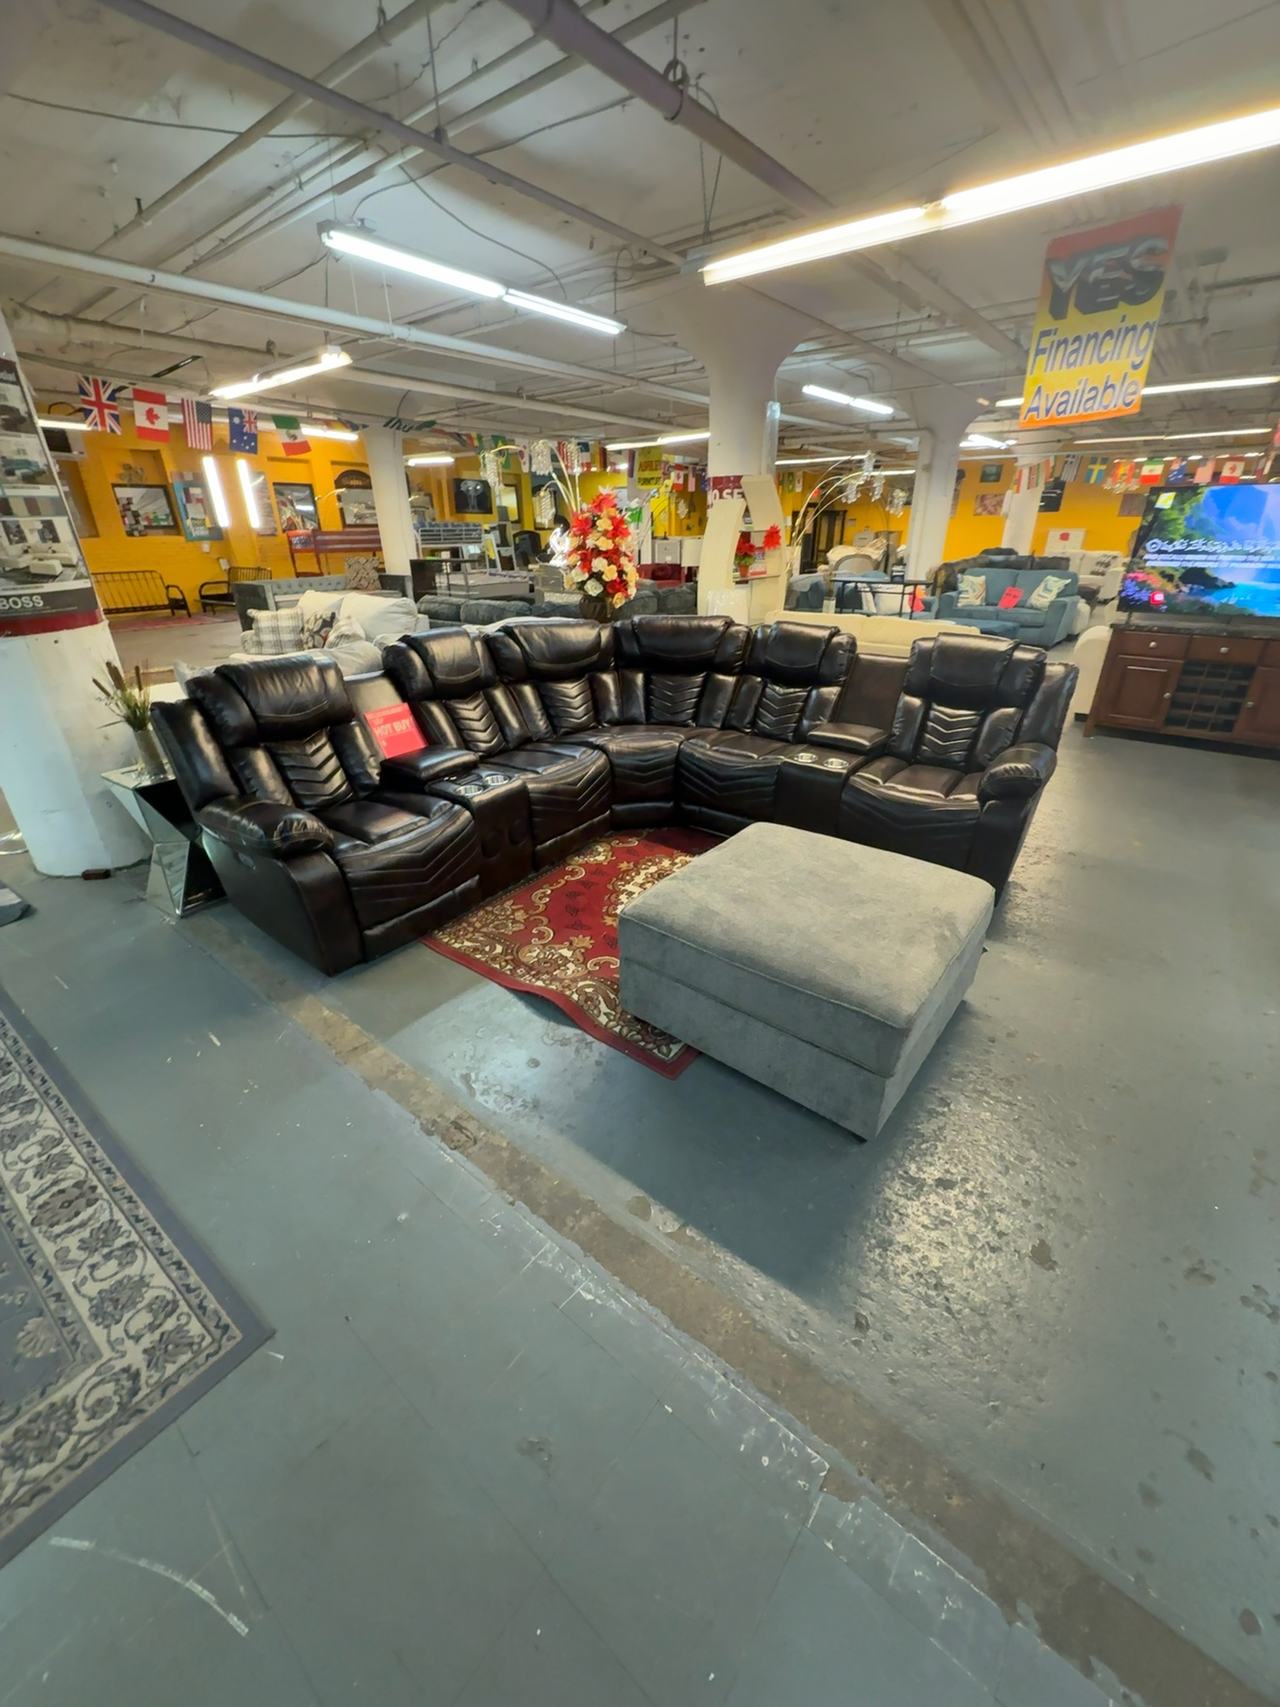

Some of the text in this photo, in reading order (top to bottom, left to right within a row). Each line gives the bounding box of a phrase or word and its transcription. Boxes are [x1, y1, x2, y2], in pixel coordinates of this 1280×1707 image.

[1030, 315, 1157, 374] Financing
[1023, 373, 1138, 420] Available
[0, 596, 44, 609] BOSS
